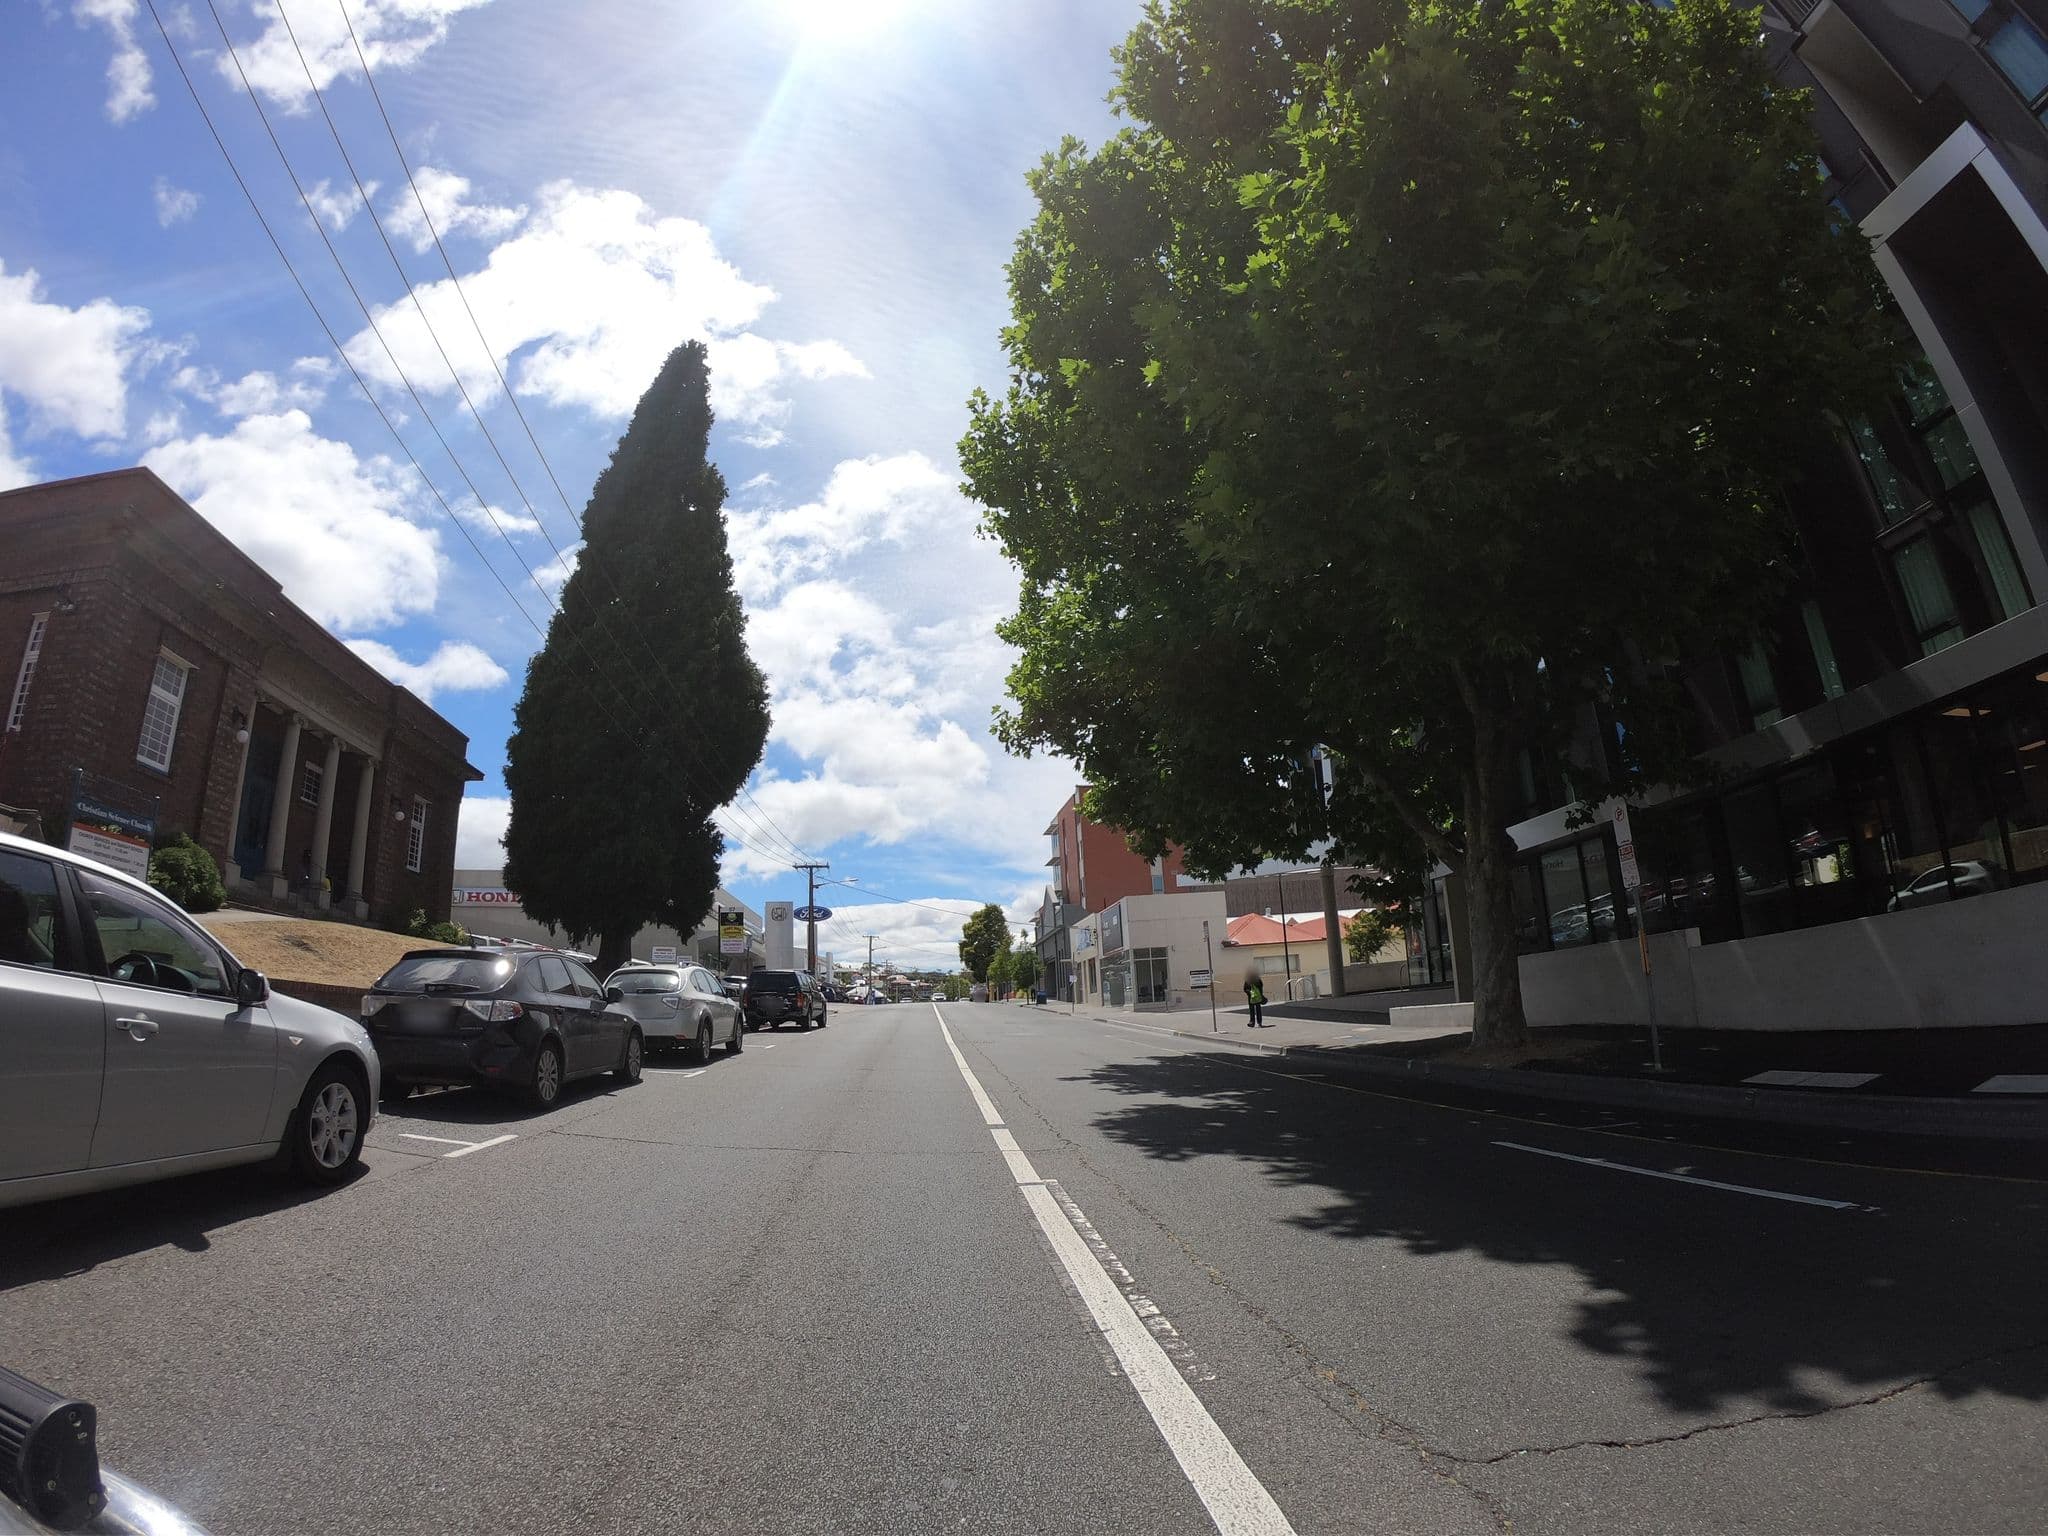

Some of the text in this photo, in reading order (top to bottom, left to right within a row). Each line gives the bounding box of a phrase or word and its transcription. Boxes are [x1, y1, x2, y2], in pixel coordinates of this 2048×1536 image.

[78, 802, 152, 832] Christian Science Church
[800, 908, 825, 918] Frd
